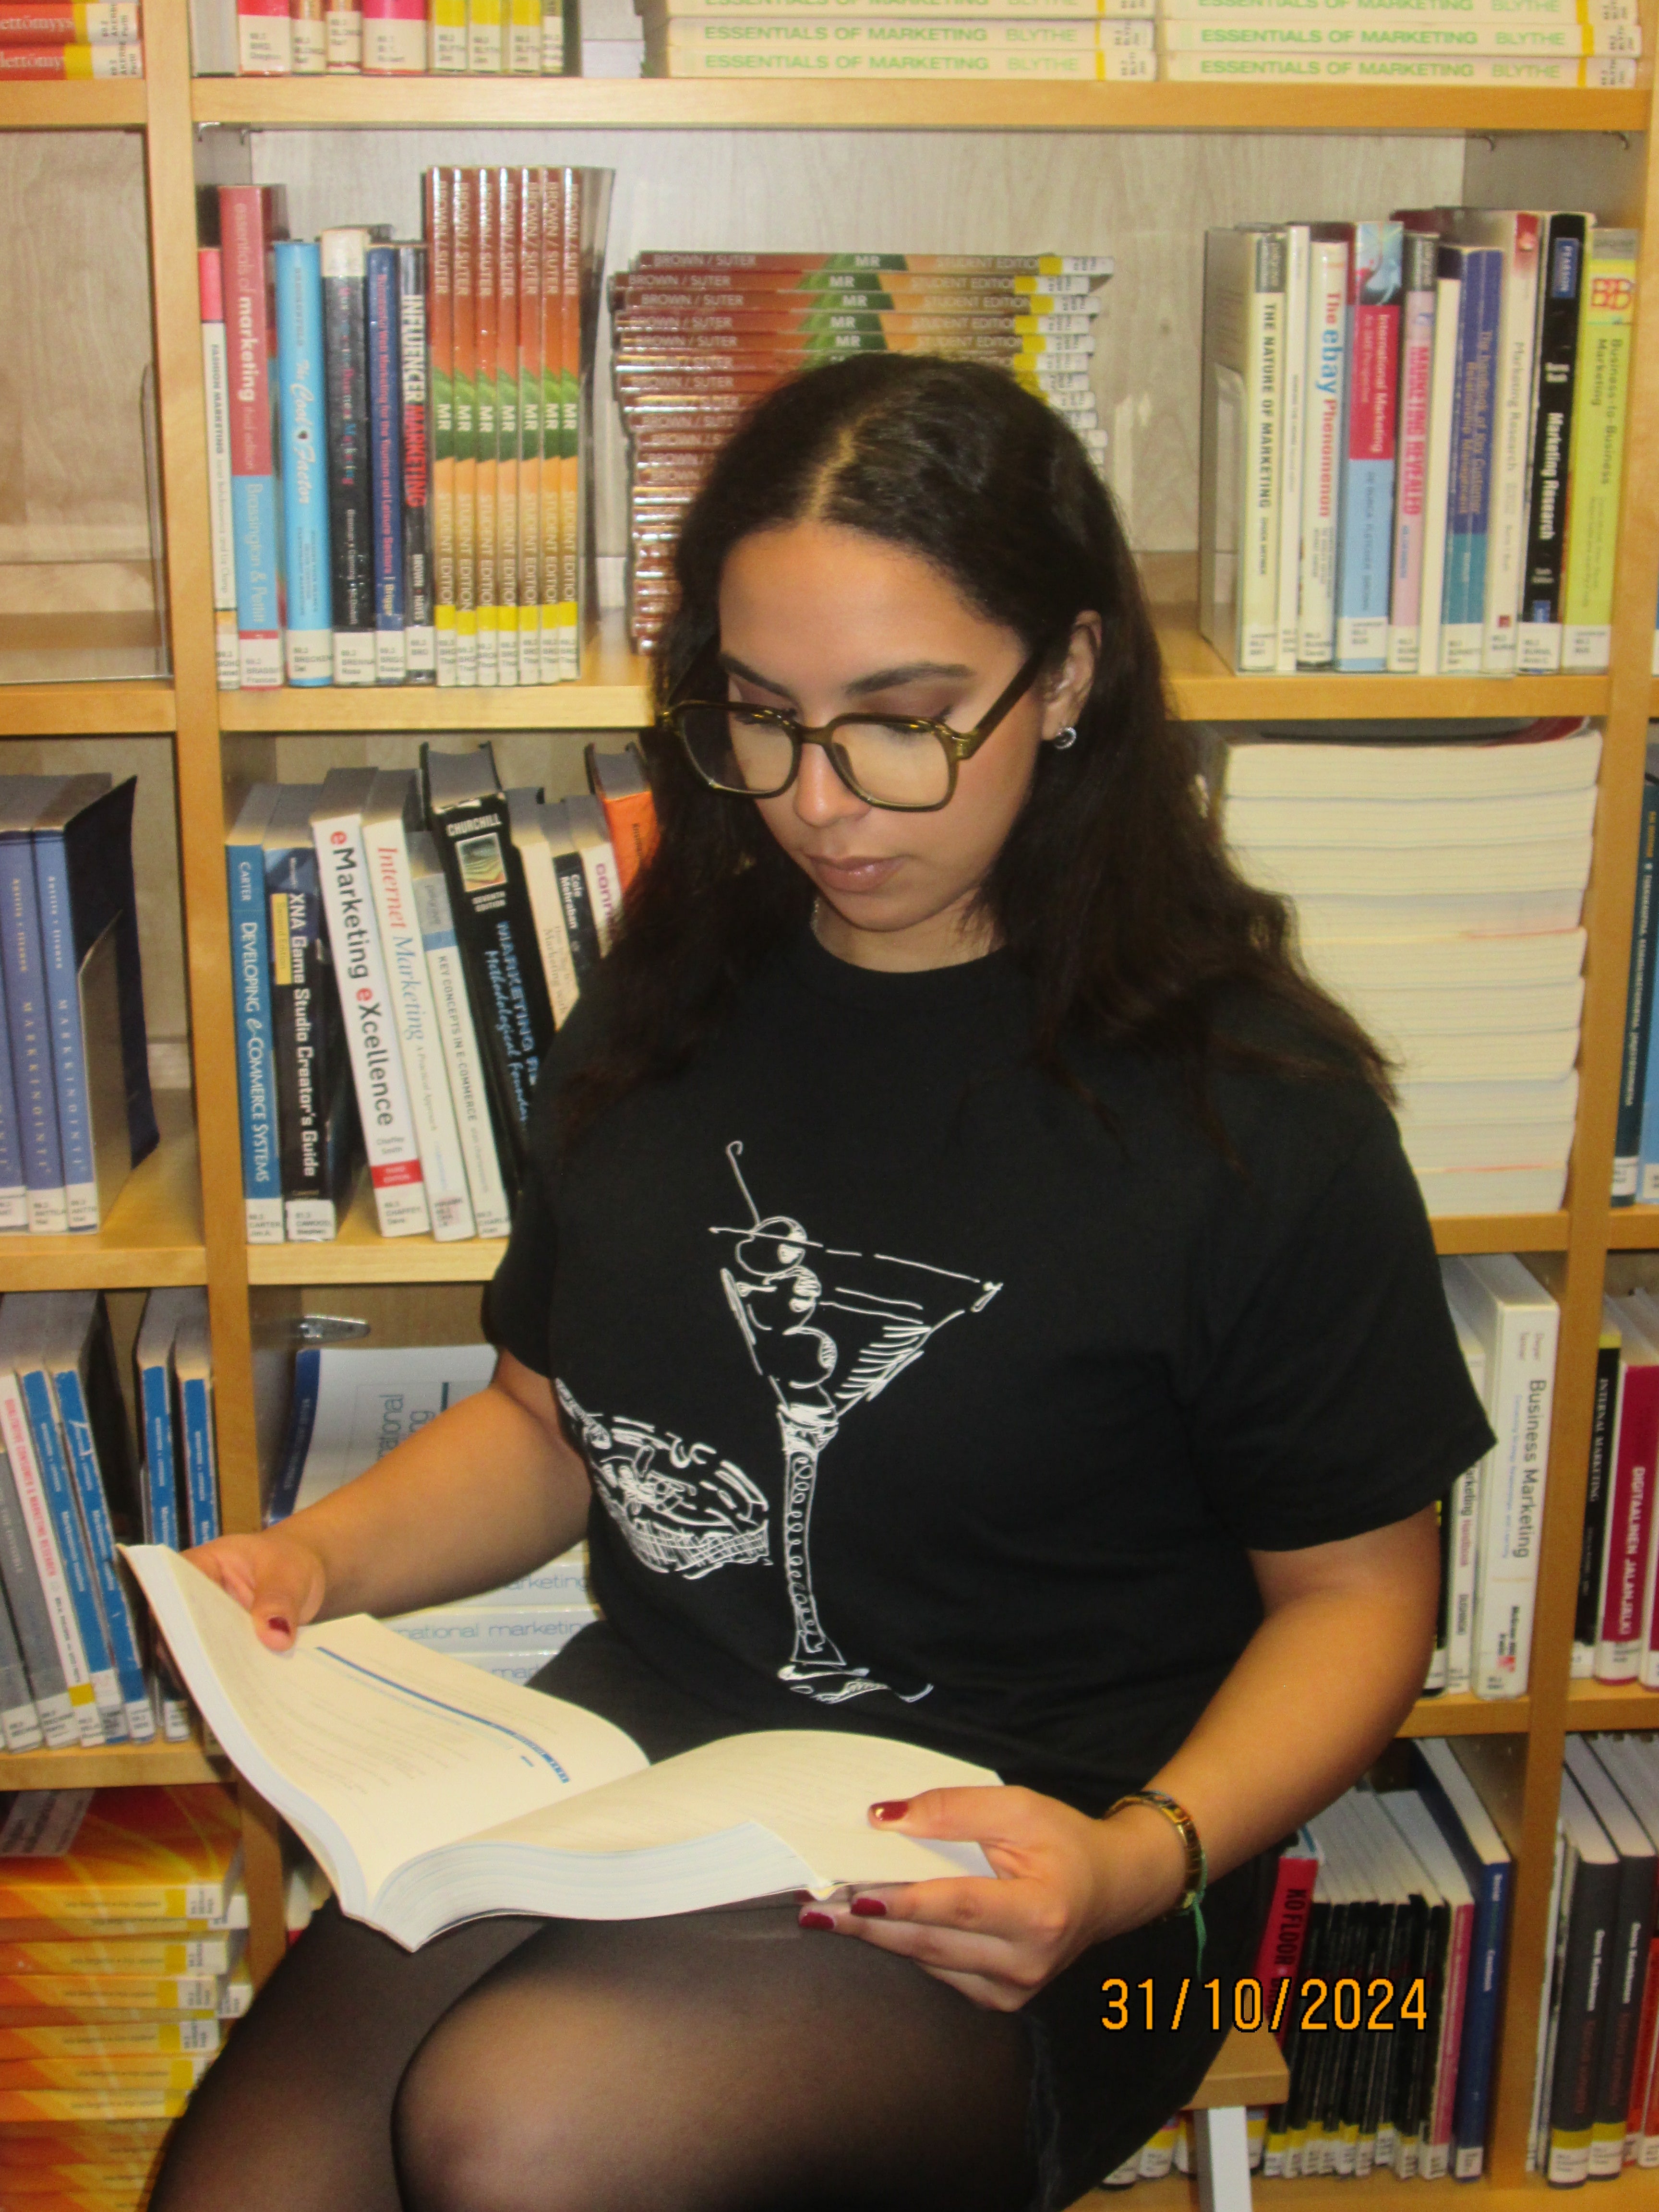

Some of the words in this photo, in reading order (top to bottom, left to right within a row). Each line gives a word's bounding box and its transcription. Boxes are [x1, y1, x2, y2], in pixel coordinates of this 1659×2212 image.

[704, 26, 828, 42] ESSENTIALS
[835, 27, 862, 42] OF
[868, 27, 988, 43] MARKETING
[1007, 28, 1078, 43] BLYTHE
[1200, 29, 1321, 43] ESSENTIALS
[1328, 30, 1355, 44] OF
[1361, 30, 1478, 45] MARKETING
[1495, 32, 1566, 46] BLYTHE
[704, 55, 829, 71] ESSENTIALS
[835, 55, 862, 71] OF
[868, 55, 990, 71] MARKETING
[1007, 57, 1080, 72] BLYTHE
[1200, 60, 1321, 75] ESSENTIALS
[1327, 61, 1353, 75] OF
[1358, 61, 1473, 77] MARKETING
[1492, 64, 1561, 78] BLYTHE
[546, 181, 559, 237] BROWN
[234, 203, 256, 275] essentials
[653, 255, 704, 266] BROWN
[716, 255, 757, 266] SUTER
[855, 256, 880, 268] MR
[937, 258, 993, 268] STUDENT
[237, 277, 257, 293] of
[457, 252, 470, 296] SUTER
[526, 251, 539, 295] SUTER
[545, 251, 558, 295] SUTER
[628, 275, 678, 287] BROWN
[691, 276, 731, 287] SUTER
[829, 276, 854, 288] MR
[378, 274, 389, 328] Successful
[641, 294, 690, 306] BROWN
[703, 295, 744, 306] SUTER
[842, 296, 867, 307] MR
[693, 317, 733, 328] SUTER
[831, 316, 855, 328] MR
[1263, 303, 1276, 330] THE
[1326, 292, 1342, 325] The
[212, 343, 221, 388] FASHION
[236, 297, 260, 402] marketing
[379, 330, 389, 352] Web
[401, 294, 426, 403] INFLUENCER
[693, 358, 734, 369] SUTER
[697, 337, 737, 348] SUTER
[835, 336, 860, 347] MR
[1262, 337, 1275, 393] NATURE
[1315, 329, 1343, 394] ebay
[1374, 314, 1389, 390] International
[1480, 332, 1493, 351] The
[295, 360, 310, 381] The
[378, 354, 390, 403] Marketing
[694, 377, 734, 388] SUTER
[1407, 346, 1430, 435] MARKETING
[1509, 342, 1526, 409] Marketing
[1591, 338, 1608, 406] Marketing
[243, 406, 256, 431] third
[289, 383, 314, 423] Cool
[381, 405, 390, 419] for
[434, 404, 448, 431] MR
[457, 405, 471, 432] MR
[479, 406, 493, 432] MR
[502, 405, 516, 432] MR
[525, 404, 538, 431] MR
[545, 403, 558, 429] MR
[563, 403, 577, 430] MR
[642, 416, 690, 427] BROWN
[1262, 399, 1274, 417] OF
[1462, 361, 1477, 434] Relationship
[1601, 338, 1624, 484] Business-to-Business
[213, 392, 223, 455] MARKETING
[381, 421, 390, 436] the
[1370, 392, 1388, 454] Marketing
[1473, 433, 1486, 454] Key
[1476, 417, 1487, 430] of
[1507, 412, 1521, 471] Research
[1540, 412, 1564, 477] Marketing
[245, 433, 256, 471] edition
[293, 442, 315, 504] Factor
[381, 439, 391, 477] Tourism
[404, 404, 427, 508] MARKETING
[1259, 422, 1273, 508] MARKETING
[1319, 398, 1339, 517] Phenomenon
[1458, 439, 1473, 514] Management
[382, 480, 392, 497] and
[1403, 441, 1425, 516] REVEALED
[1471, 458, 1485, 514] Customer
[244, 483, 264, 567] Brassington
[382, 500, 393, 535] Leisure
[436, 492, 450, 553] STUDENT
[459, 493, 472, 554] STUDENT
[480, 495, 493, 554] STUDENT
[503, 494, 516, 553] STUDENT
[522, 491, 535, 553] STUDENT
[545, 491, 558, 552] STUDENT
[563, 491, 575, 552] STUDENT
[1539, 480, 1560, 540] Research
[250, 570, 266, 583] &
[384, 537, 394, 574] Sectors
[412, 554, 424, 587] BROWN
[239, 861, 252, 901] CARTER
[377, 847, 407, 928] Internet
[276, 902, 288, 937] Second
[288, 892, 308, 930] XNA
[240, 922, 259, 1012] DEVELOPING
[278, 938, 289, 970] Edition
[290, 936, 309, 984] Game
[330, 831, 371, 979] eMarketing
[355, 987, 395, 1126] eXcellence
[437, 955, 452, 976] KEY
[543, 929, 563, 987] Marketing
[556, 991, 568, 1014] with
[388, 936, 427, 1041] Marketing
[442, 979, 461, 1035] CONCEPTS
[484, 950, 522, 1057] Methodological
[495, 921, 536, 1052] MARKETING
[293, 988, 313, 1042] Studio
[452, 1037, 464, 1048] IN
[23, 1001, 47, 1166] MARKKINOINTI
[58, 999, 83, 1164] MARKKINOINTI
[295, 1046, 316, 1126] Creator's
[456, 1051, 478, 1122] E-COMMERCE
[252, 1123, 270, 1181] SYSTEMS
[301, 1130, 320, 1177] Guide
[1523, 1379, 1548, 1463] Business
[1593, 1378, 1609, 1433] INTERNAL
[1459, 1468, 1482, 1516] arketing
[1588, 1437, 1604, 1502] MARKETING
[16, 1445, 34, 1487] CONSUMER
[28, 1496, 46, 1538] MARKETING
[37, 1539, 57, 1577] RESEARCH
[1512, 1468, 1541, 1559] Marketing
[1625, 1466, 1646, 1555] DIGITAALINEN
[1460, 1518, 1473, 1567] Handbook
[504, 1574, 587, 1592] arketing
[489, 1621, 585, 1637] marketin
[1274, 1914, 1303, 1965] FLOOR
